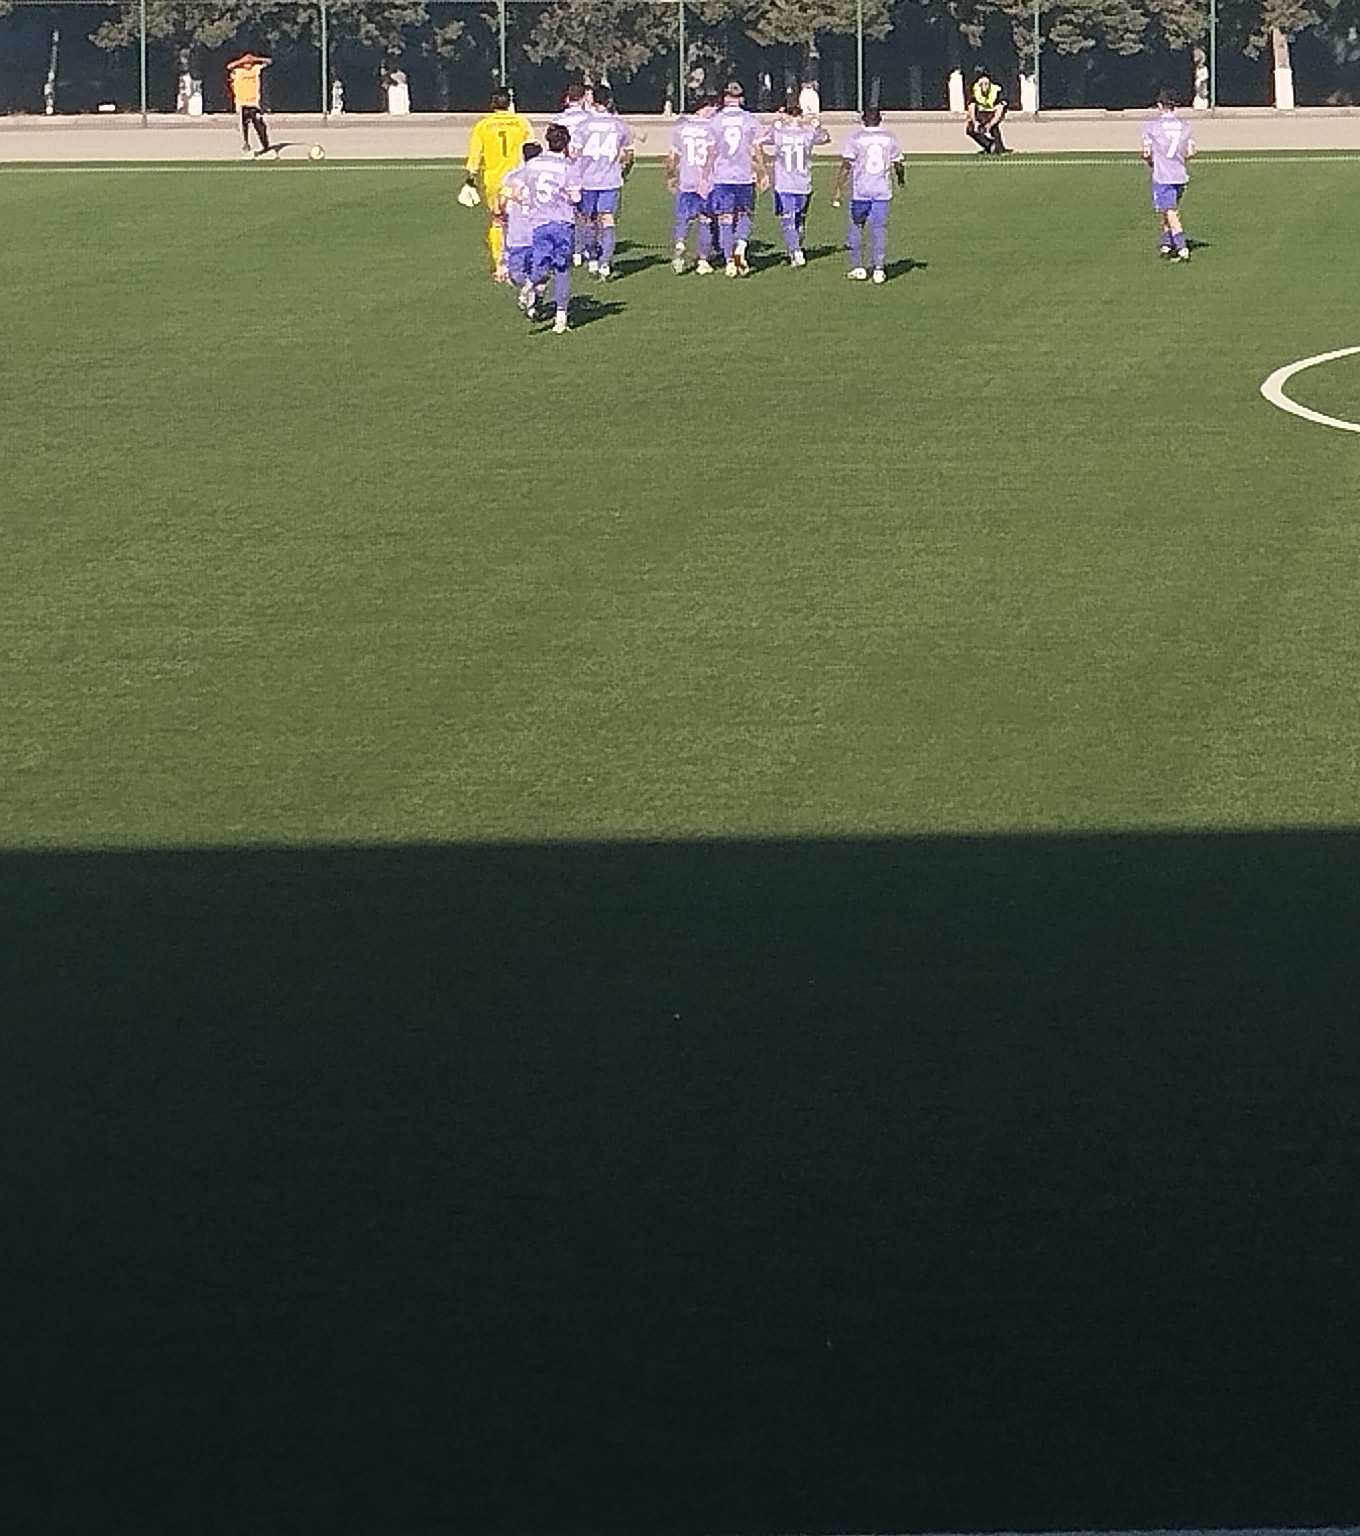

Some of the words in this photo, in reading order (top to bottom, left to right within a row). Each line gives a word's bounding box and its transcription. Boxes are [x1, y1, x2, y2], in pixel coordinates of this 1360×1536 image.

[498, 130, 508, 158] 1
[583, 132, 618, 164] 44
[683, 136, 708, 166] 13
[724, 126, 742, 155] 9
[1165, 131, 1181, 158] 7
[781, 144, 804, 172] 11
[865, 144, 885, 174] 8
